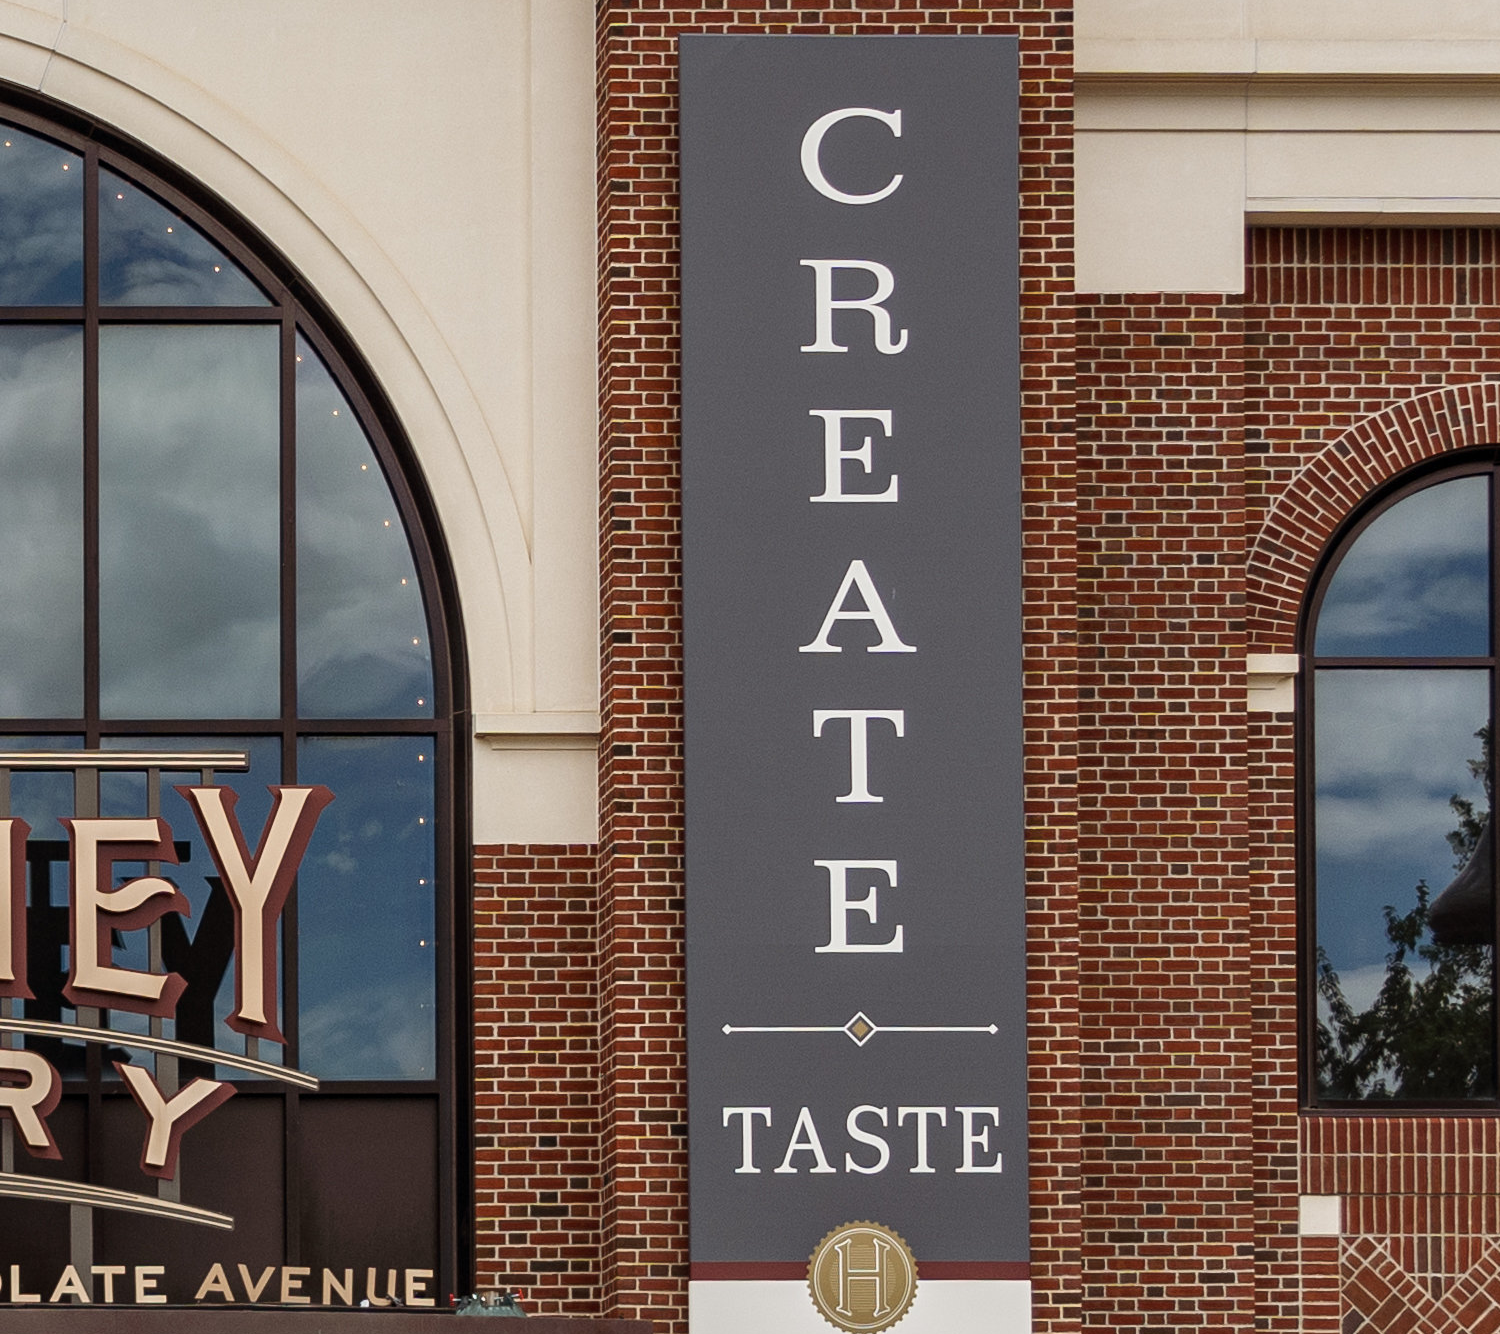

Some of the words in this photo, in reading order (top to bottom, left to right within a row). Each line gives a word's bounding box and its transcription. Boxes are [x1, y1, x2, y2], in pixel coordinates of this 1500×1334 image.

[797, 106, 918, 955] CREATE
[721, 1104, 1003, 1175] TASTE
[193, 1261, 436, 1308] AVENUE
